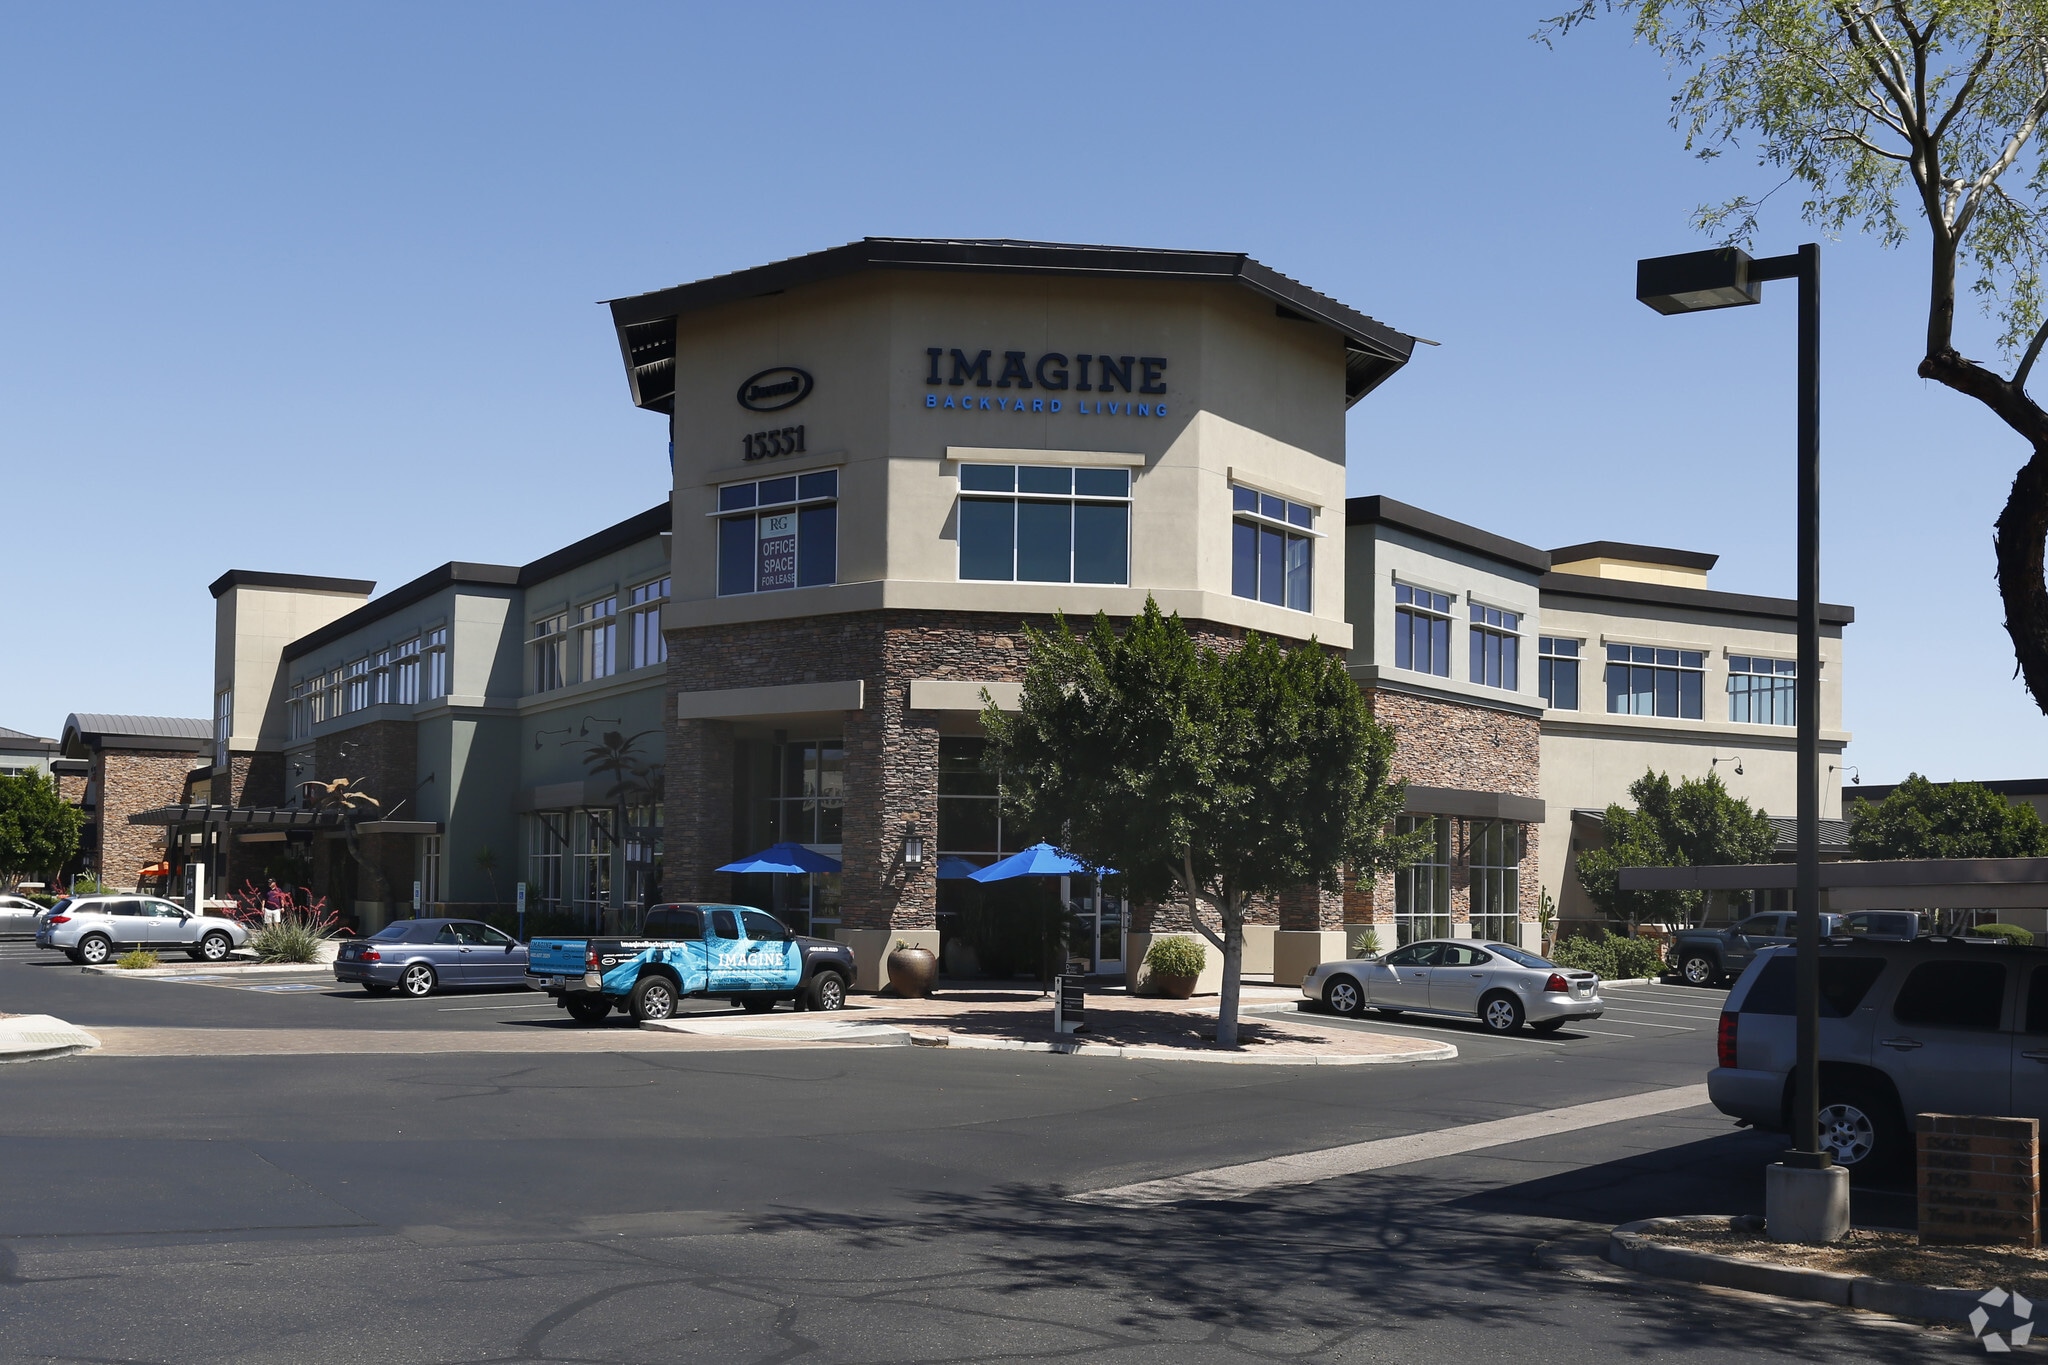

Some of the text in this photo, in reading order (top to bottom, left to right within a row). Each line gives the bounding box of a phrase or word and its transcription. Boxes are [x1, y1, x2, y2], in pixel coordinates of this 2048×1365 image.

[926, 347, 1168, 395] IMAGINE
[926, 394, 1168, 418] BACKYARD LIVING
[742, 425, 807, 462] 15551
[763, 538, 795, 556] OFFICE
[764, 556, 794, 574] SPACE
[761, 573, 795, 587] FOR LEASE
[718, 953, 784, 967] IMAGINE
